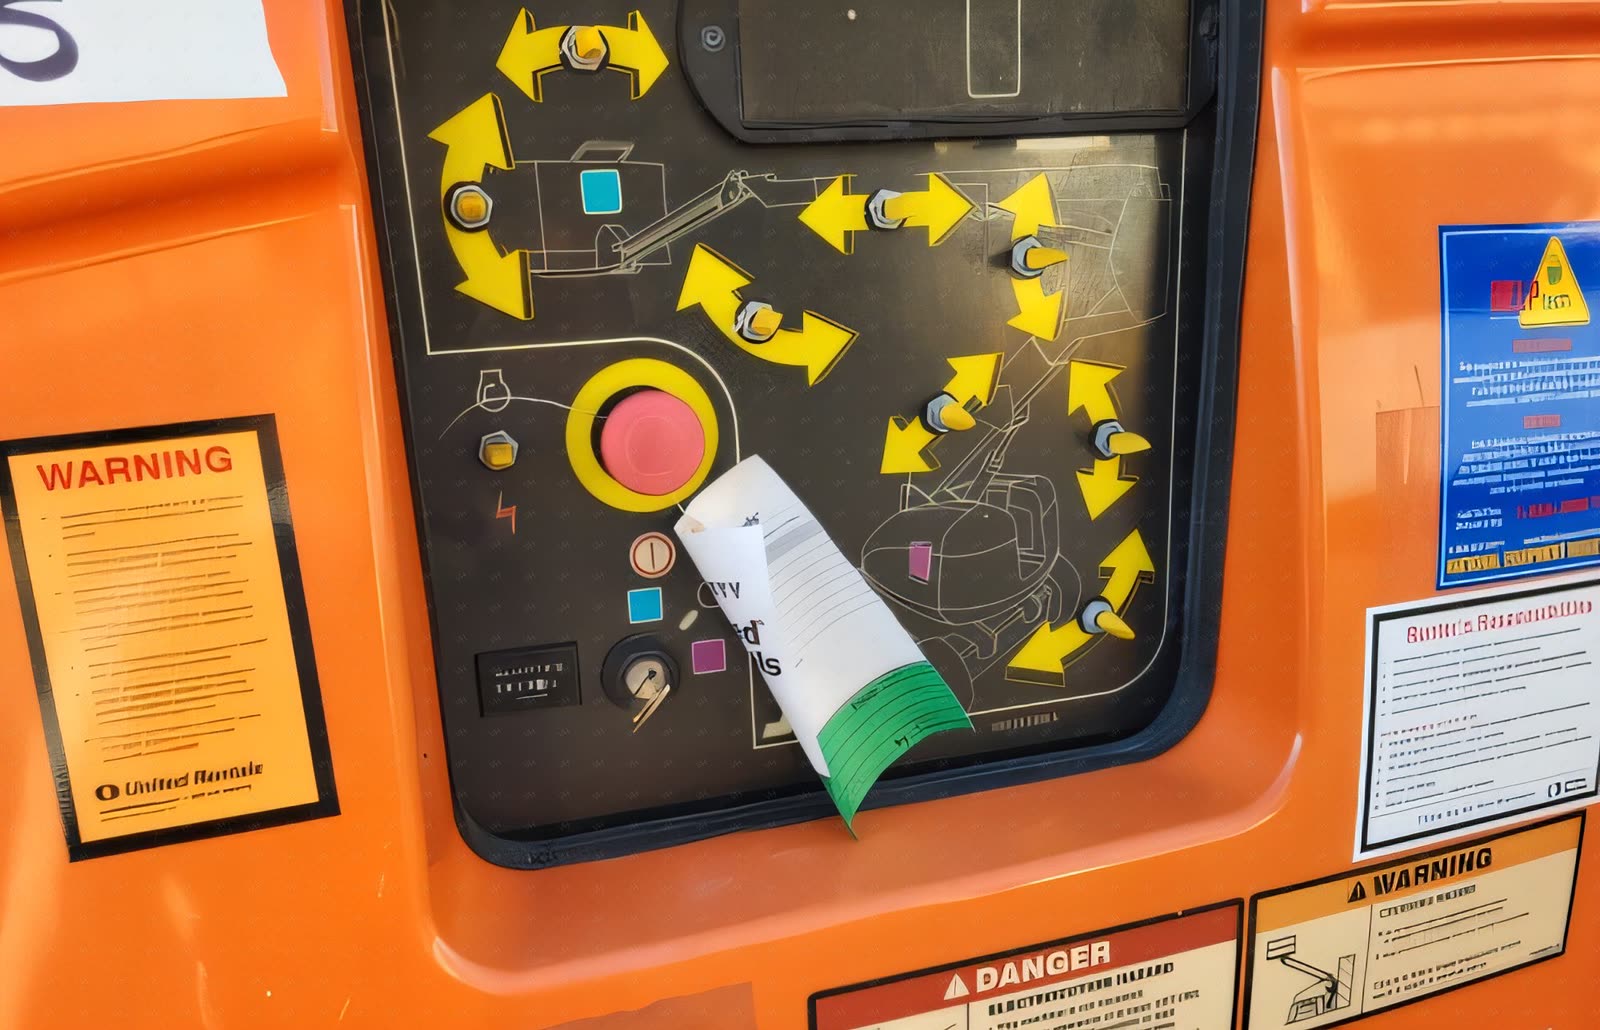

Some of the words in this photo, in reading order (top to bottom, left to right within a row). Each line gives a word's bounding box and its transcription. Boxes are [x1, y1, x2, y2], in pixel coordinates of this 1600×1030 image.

[36, 446, 233, 491] WARNING
[1373, 847, 1492, 896] WARNING
[976, 940, 1111, 993] DANGER
